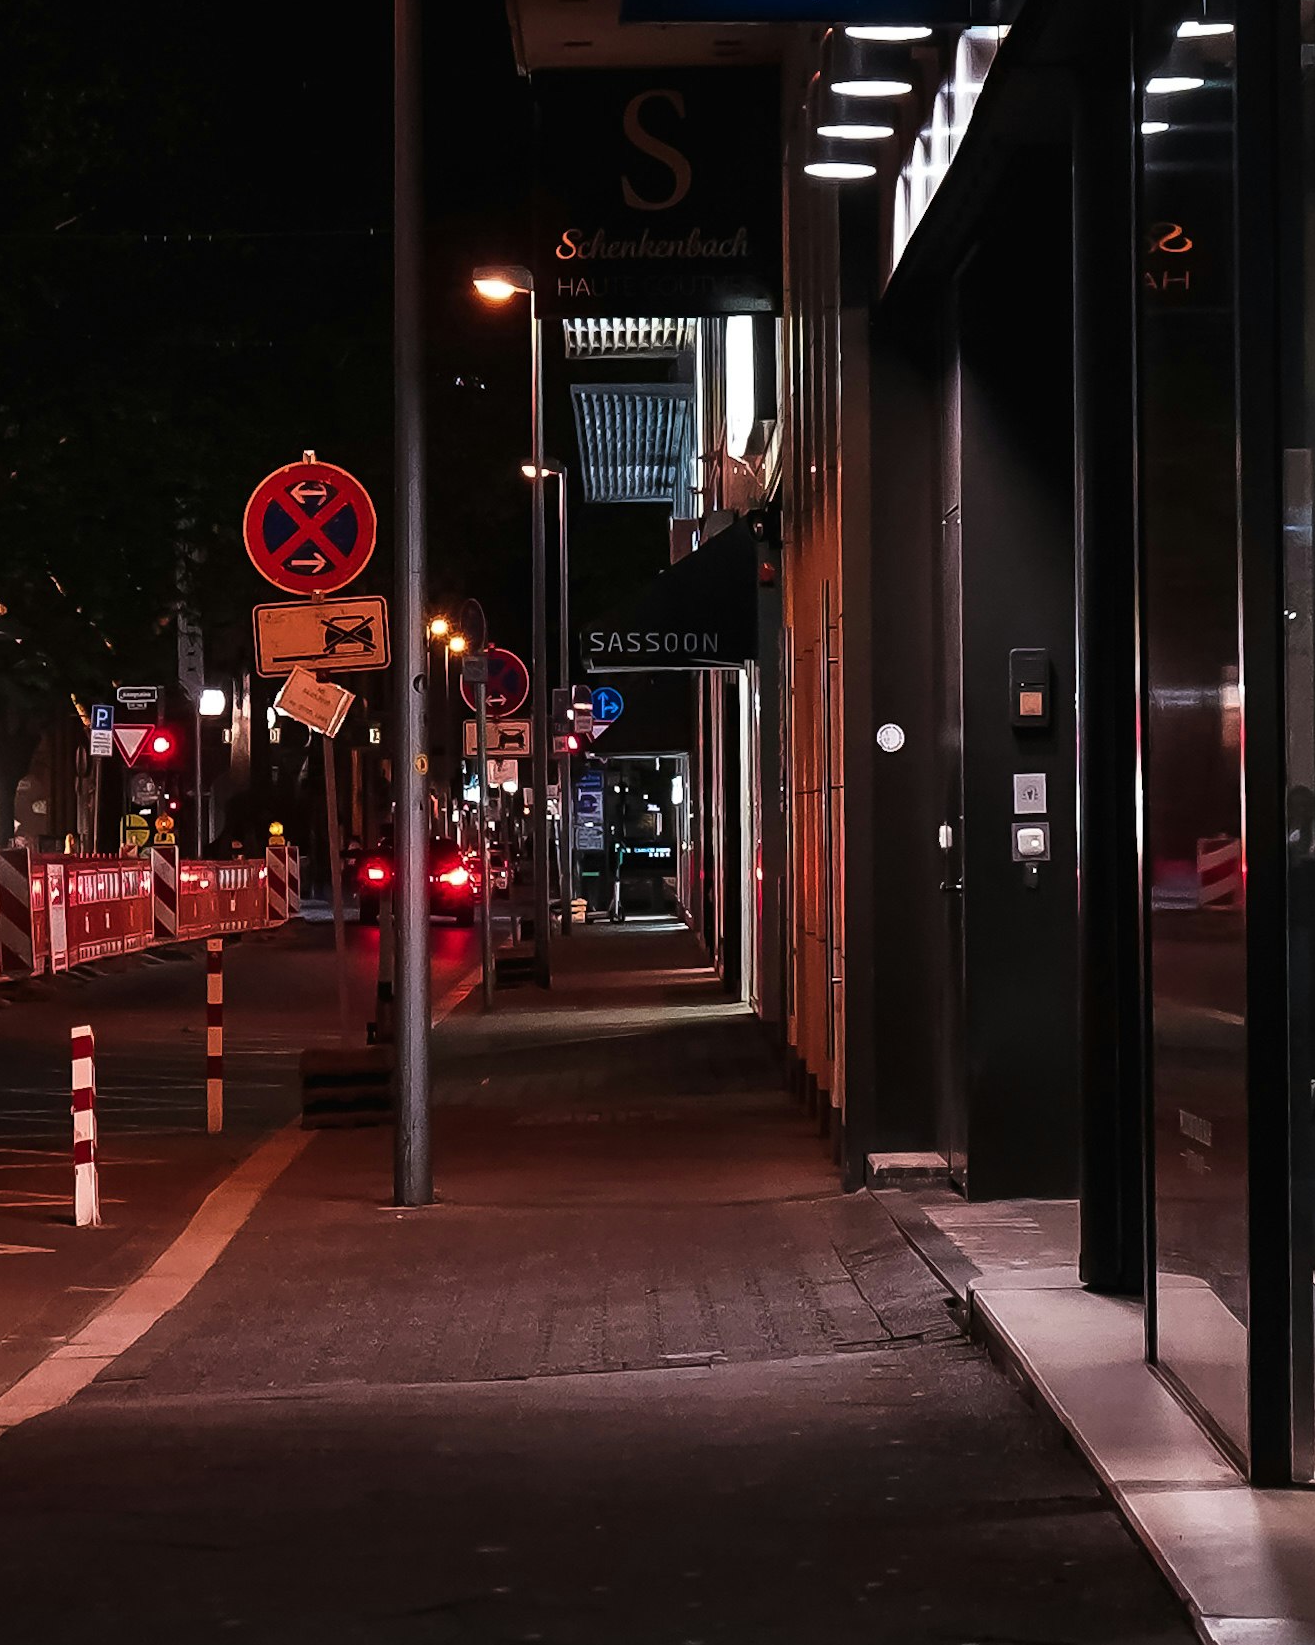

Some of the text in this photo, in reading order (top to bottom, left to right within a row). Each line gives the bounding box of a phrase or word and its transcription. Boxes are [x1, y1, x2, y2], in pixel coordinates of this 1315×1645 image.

[620, 87, 693, 212] S
[555, 226, 749, 261] Schenkenbach
[589, 632, 719, 653] SASSOON
[96, 709, 109, 728] P
